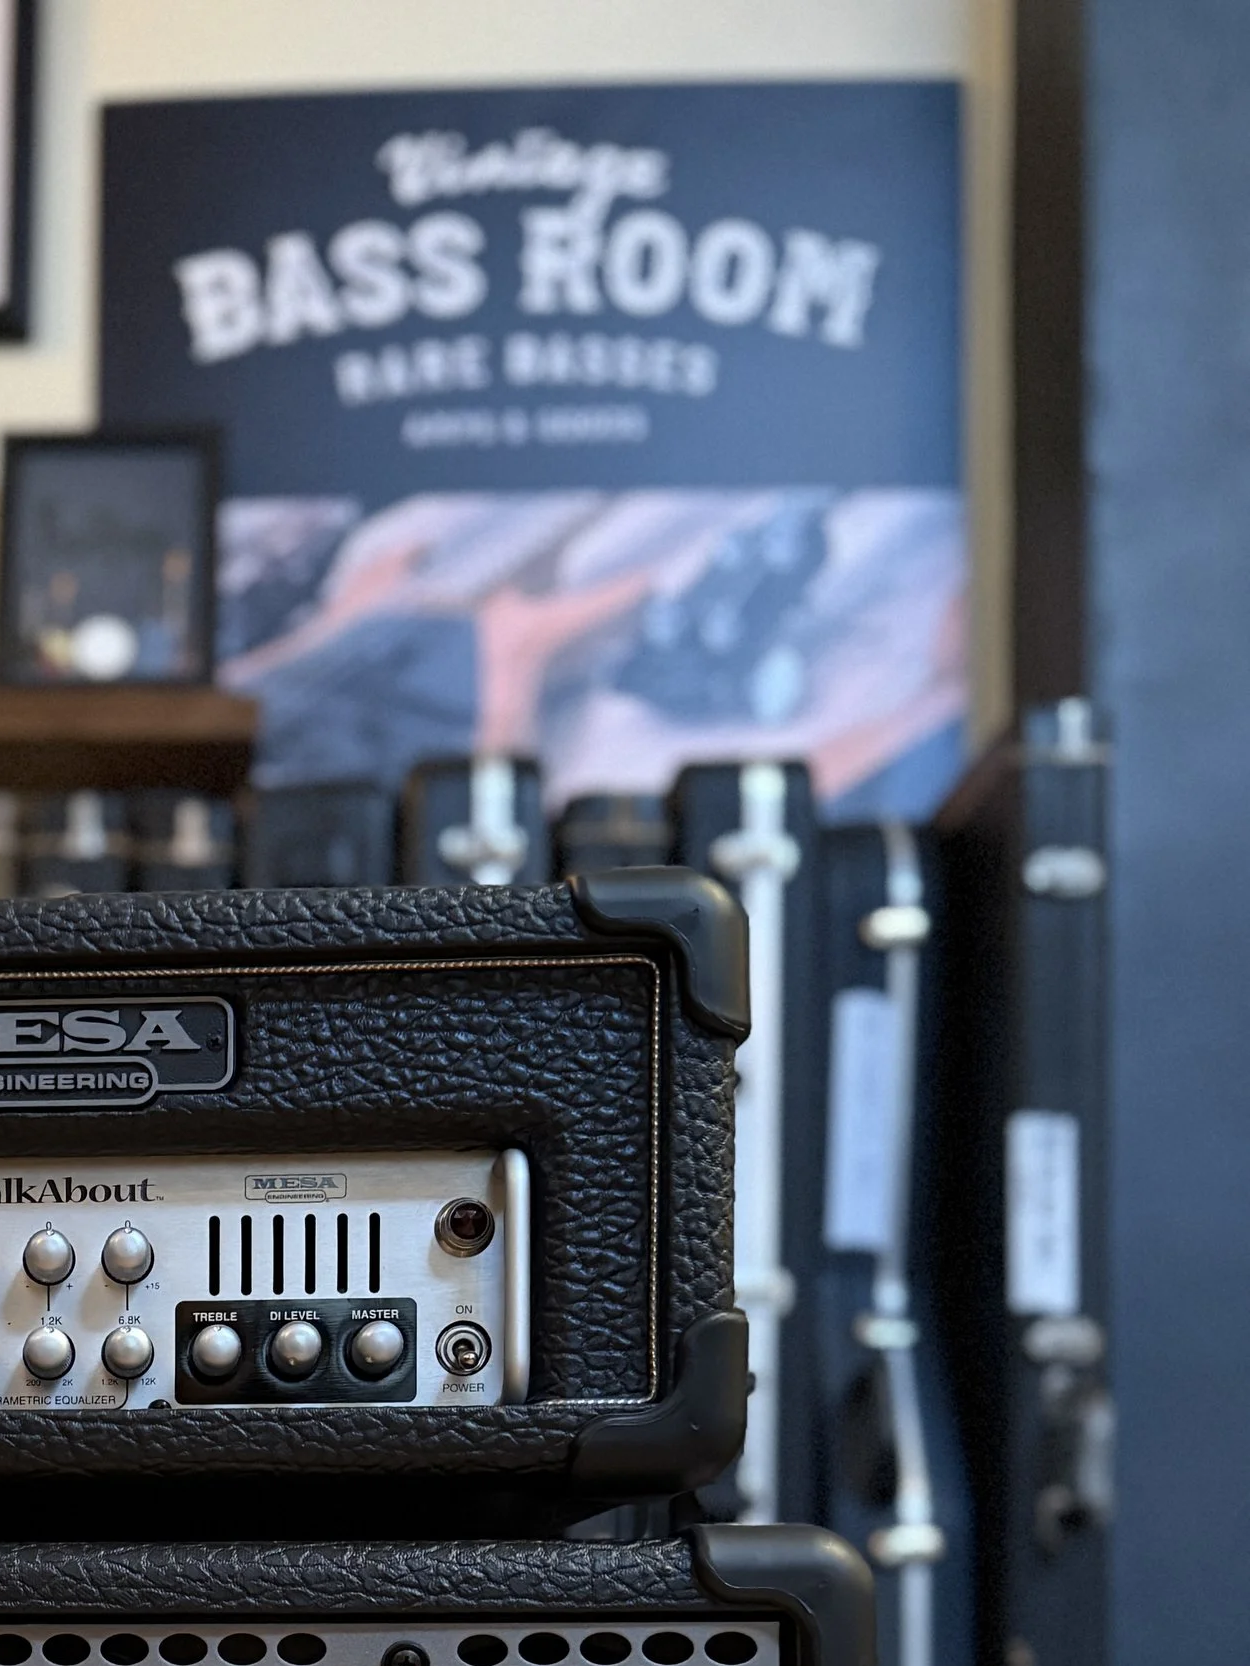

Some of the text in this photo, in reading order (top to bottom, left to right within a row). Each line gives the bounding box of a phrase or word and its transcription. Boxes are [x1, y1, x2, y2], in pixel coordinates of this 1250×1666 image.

[174, 207, 879, 365] BASS ROOM
[252, 1176, 339, 1190] MESA
[351, 1309, 400, 1320] MASTER
[455, 1304, 473, 1315] ON
[118, 1315, 141, 1326] 6.8K
[192, 1312, 238, 1322] TREBLE
[269, 1310, 320, 1321] DI LEVEL
[62, 1378, 74, 1387] 2K
[141, 1377, 156, 1387] 12K
[442, 1382, 485, 1393] POWER
[54, 1395, 116, 1405] EQUALIZER
